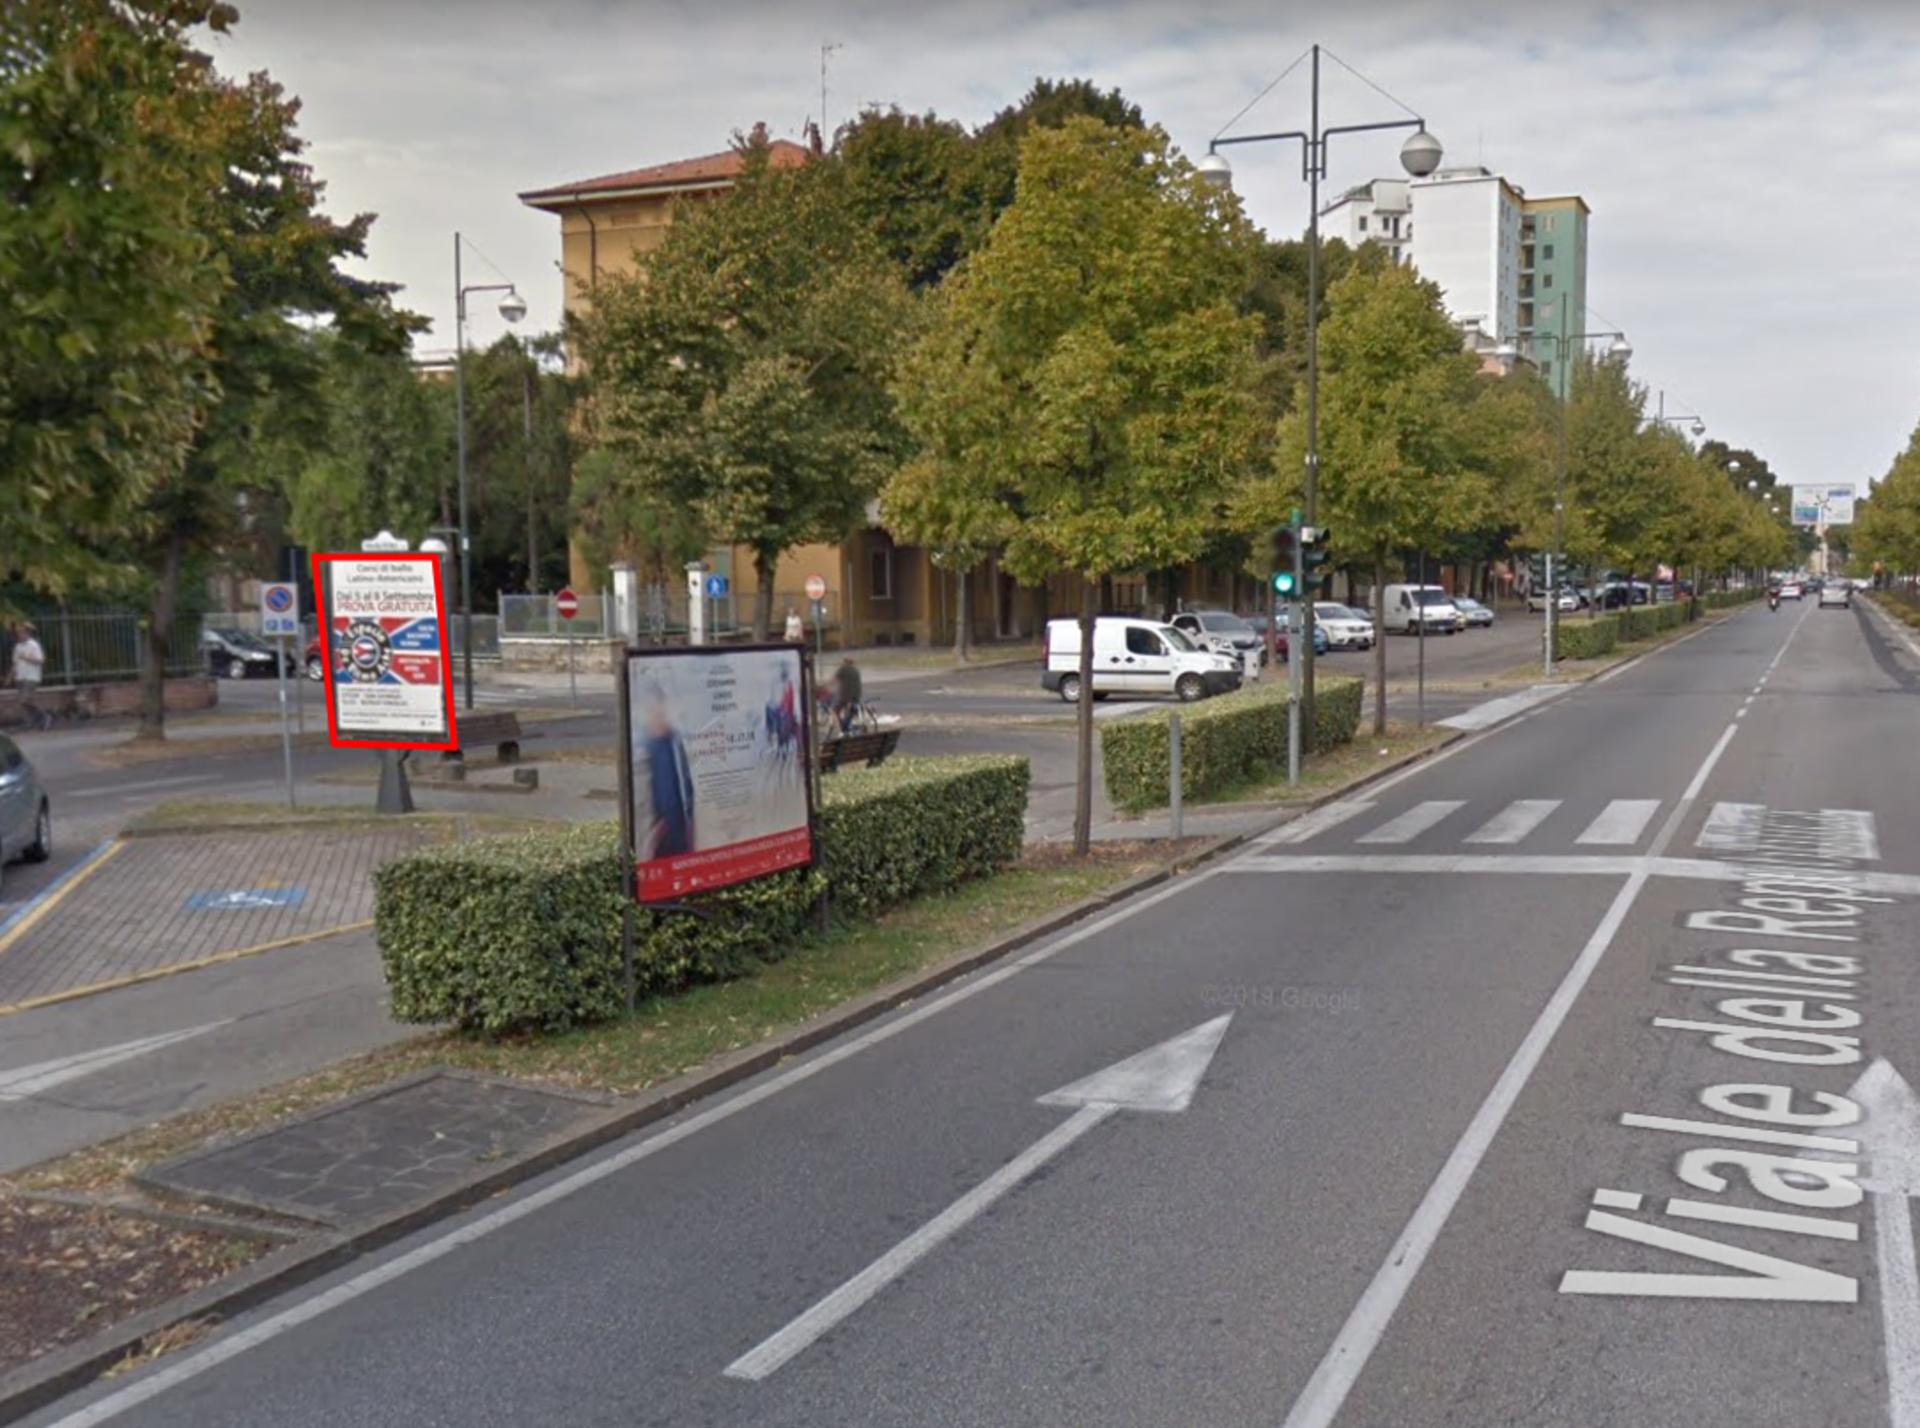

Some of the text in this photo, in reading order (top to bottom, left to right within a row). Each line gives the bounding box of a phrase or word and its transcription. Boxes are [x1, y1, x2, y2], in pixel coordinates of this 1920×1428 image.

[356, 563, 378, 572] Corsi
[380, 563, 389, 572] di
[336, 591, 352, 600] Dal
[383, 591, 434, 600] Settembre
[337, 601, 434, 612] PROVA GRATUITA
